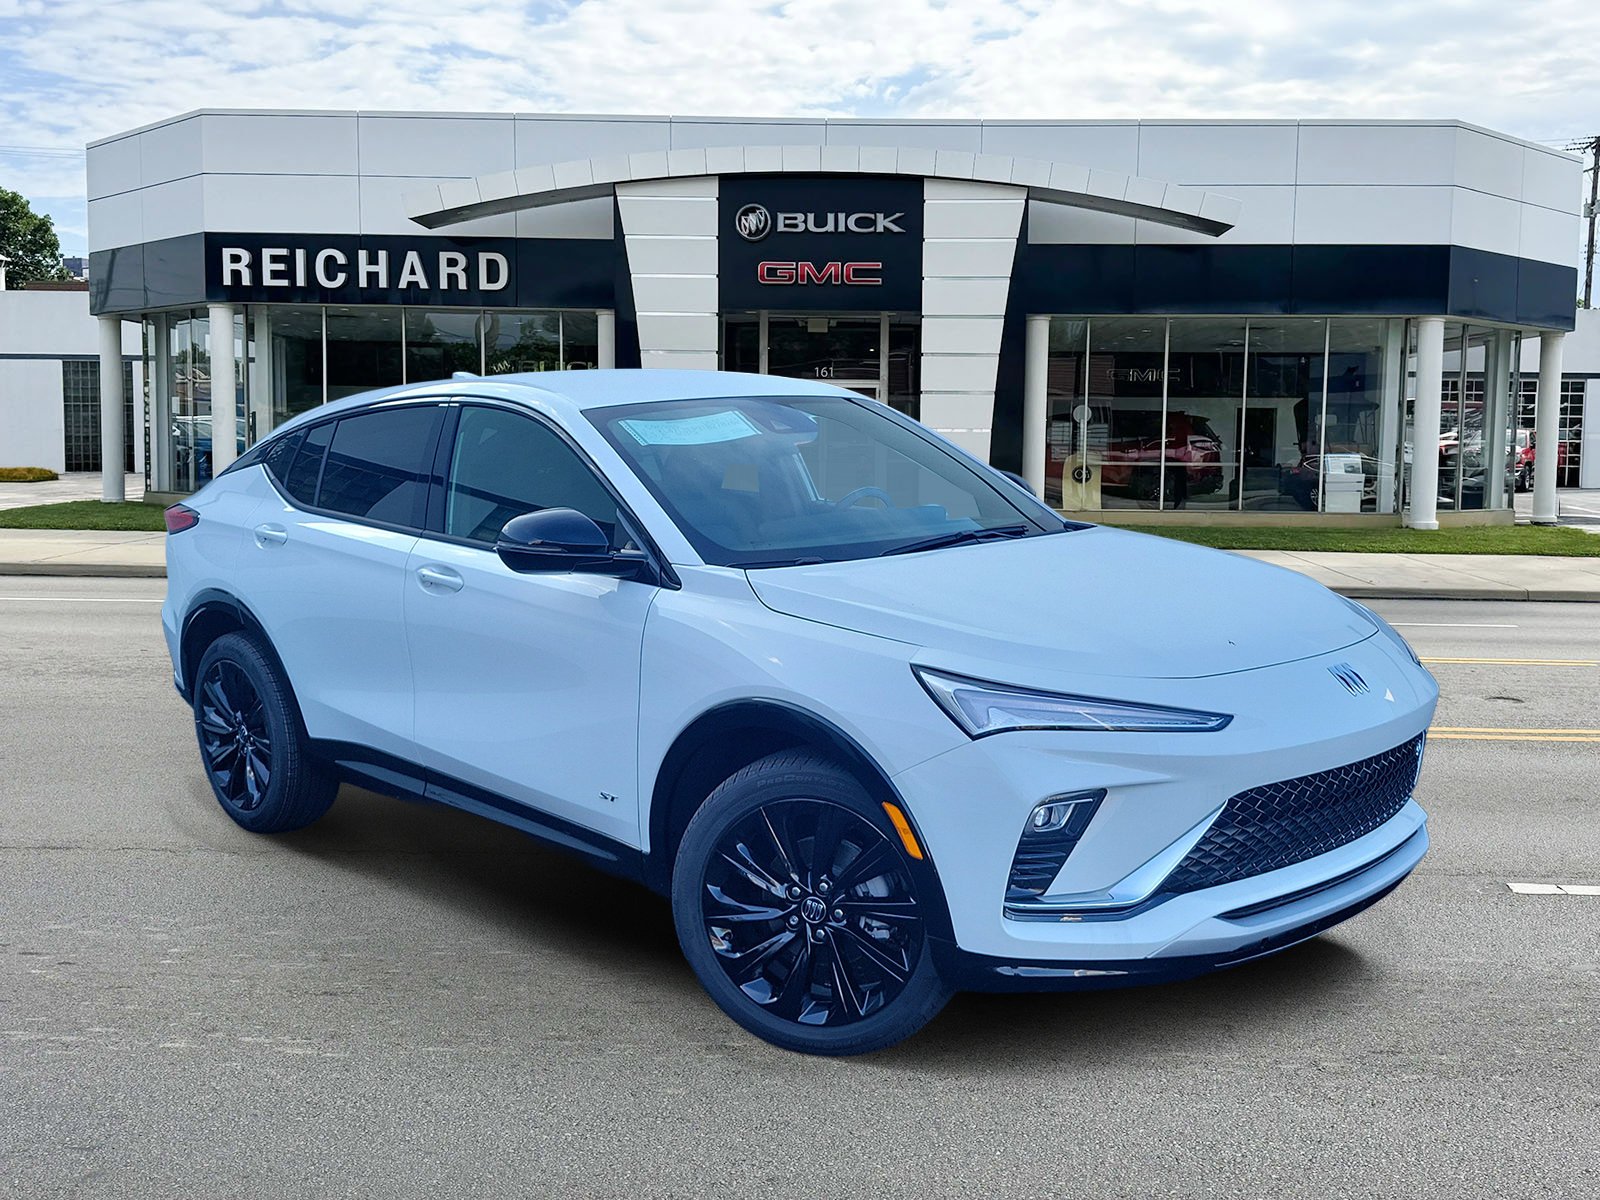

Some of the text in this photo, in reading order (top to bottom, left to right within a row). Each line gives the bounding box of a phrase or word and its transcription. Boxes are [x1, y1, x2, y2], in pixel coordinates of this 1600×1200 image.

[776, 212, 906, 233] BUICK
[222, 247, 510, 291] REICHARD
[758, 261, 882, 285] GMC
[814, 366, 833, 378] 161
[1106, 368, 1181, 382] GMC
[599, 791, 619, 802] ST
